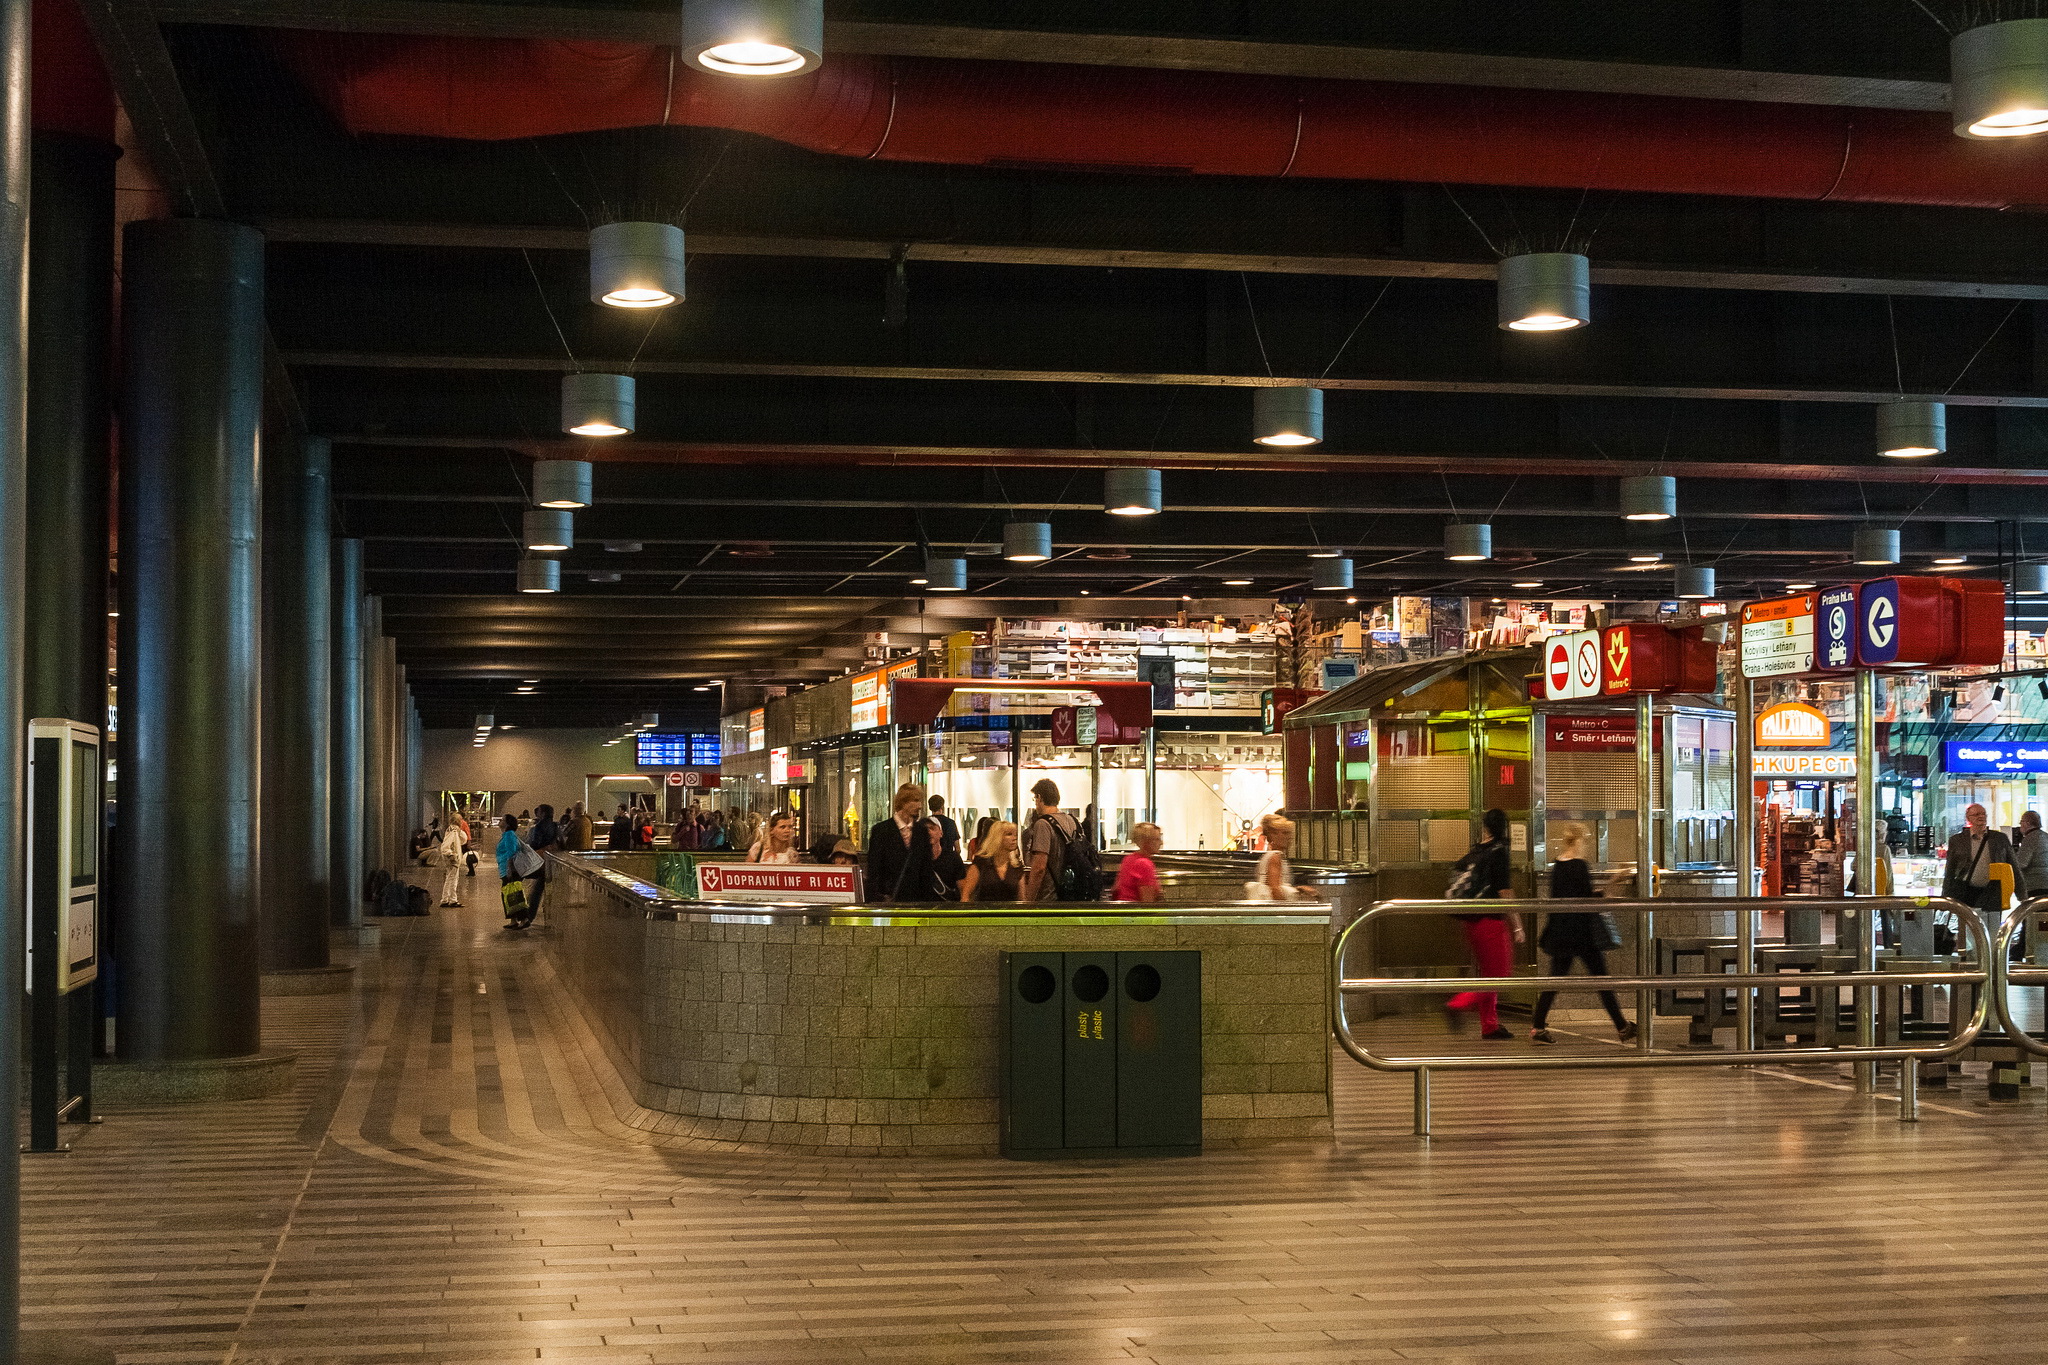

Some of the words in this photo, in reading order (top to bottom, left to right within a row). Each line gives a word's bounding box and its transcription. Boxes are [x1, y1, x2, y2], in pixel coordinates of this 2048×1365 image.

[1822, 593, 1840, 606] Praha
[1754, 607, 1769, 617] Metro
[1744, 627, 1766, 638] Florenc
[1787, 621, 1793, 632] B
[1744, 646, 1769, 658] Kobylisy
[1772, 641, 1797, 654] Letňany
[1744, 663, 1761, 675] Praha
[1764, 660, 1797, 672] Holešovice
[1572, 720, 1596, 729] Metro
[1601, 720, 1609, 729] C
[1572, 732, 1596, 743] Směr
[1601, 732, 1637, 745] Letňany
[1958, 748, 2003, 762] Change
[726, 873, 780, 887] DOPRAVNÍ
[1077, 1011, 1089, 1039] plasty
[1092, 1010, 1104, 1040] plastic
